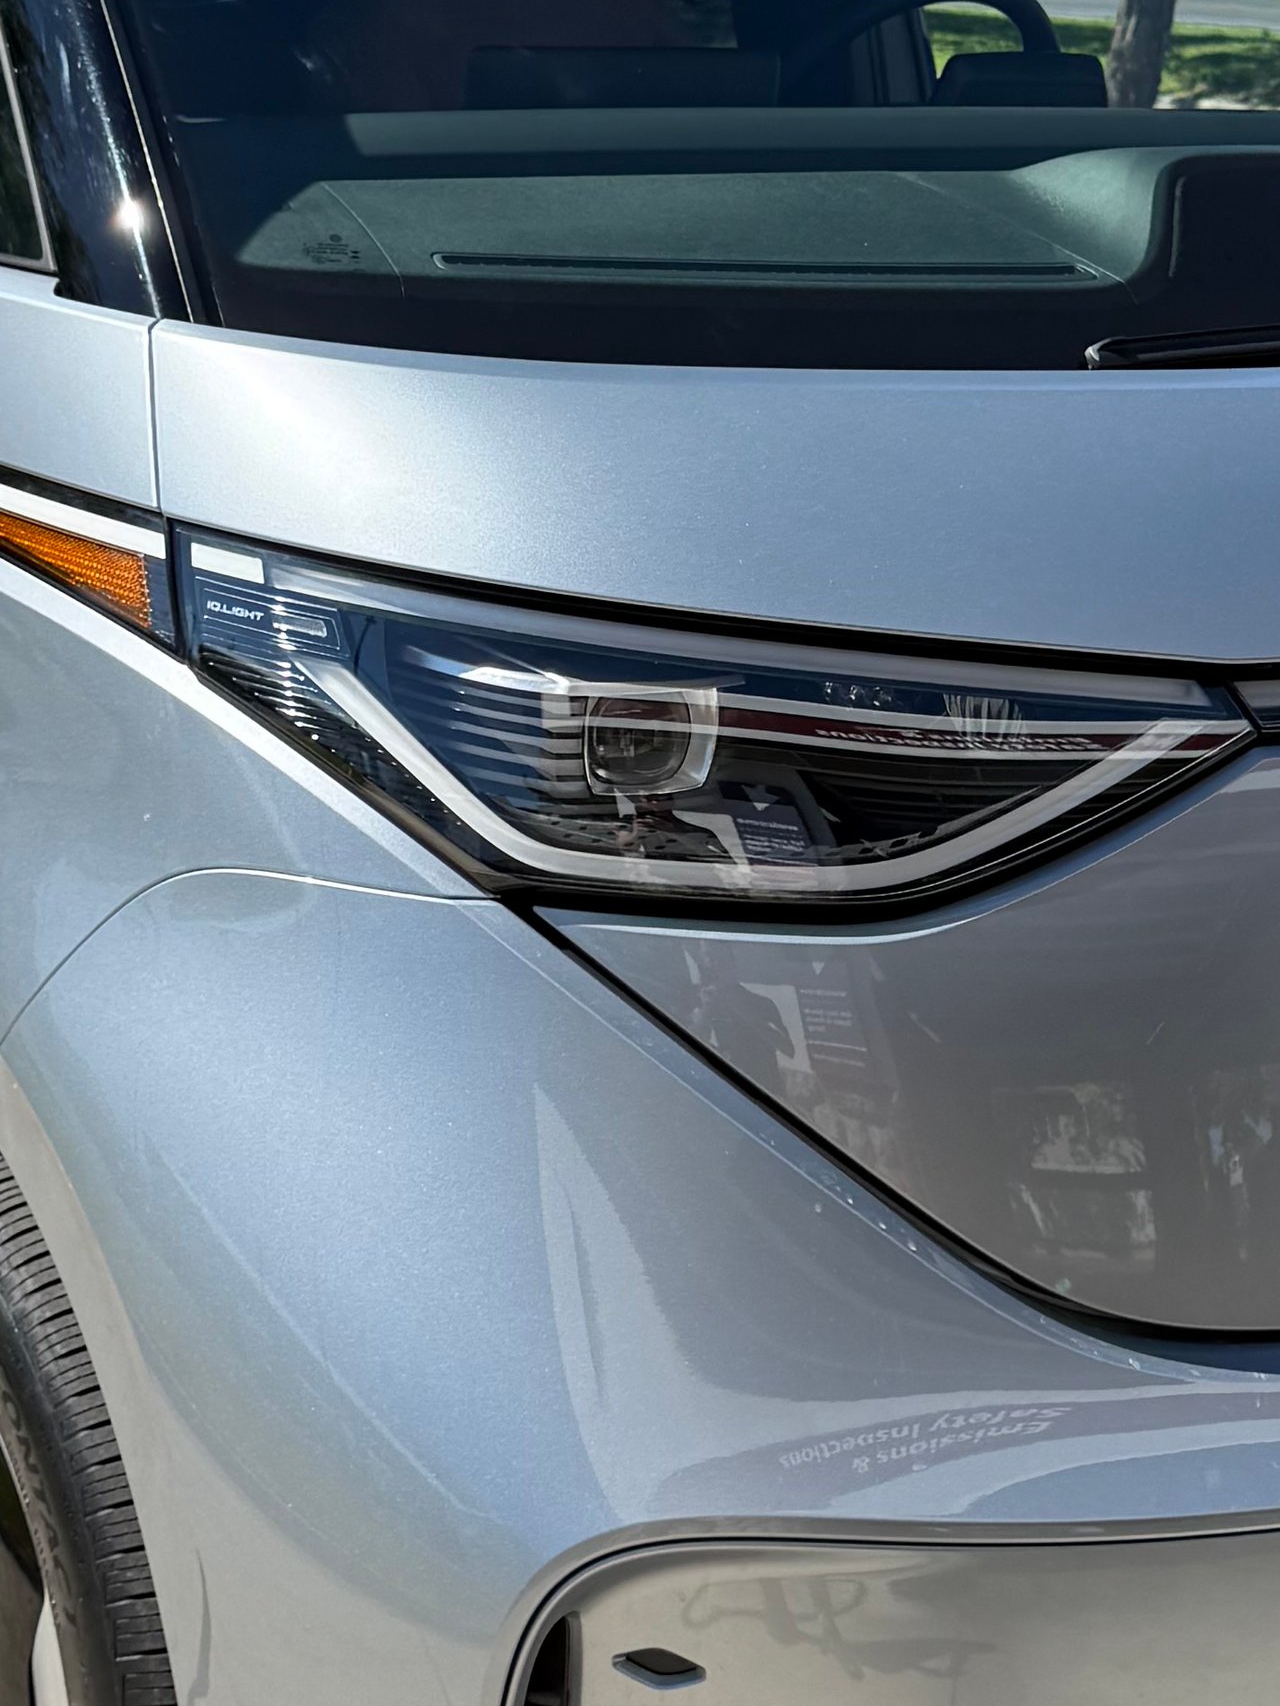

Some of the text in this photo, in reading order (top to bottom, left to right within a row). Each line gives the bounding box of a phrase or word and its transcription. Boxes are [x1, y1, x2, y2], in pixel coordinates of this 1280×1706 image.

[206, 600, 265, 621] IQ.LIGHT
[778, 1406, 1073, 1468] Safety Inspections
[852, 1420, 1053, 1473] Emissions &
